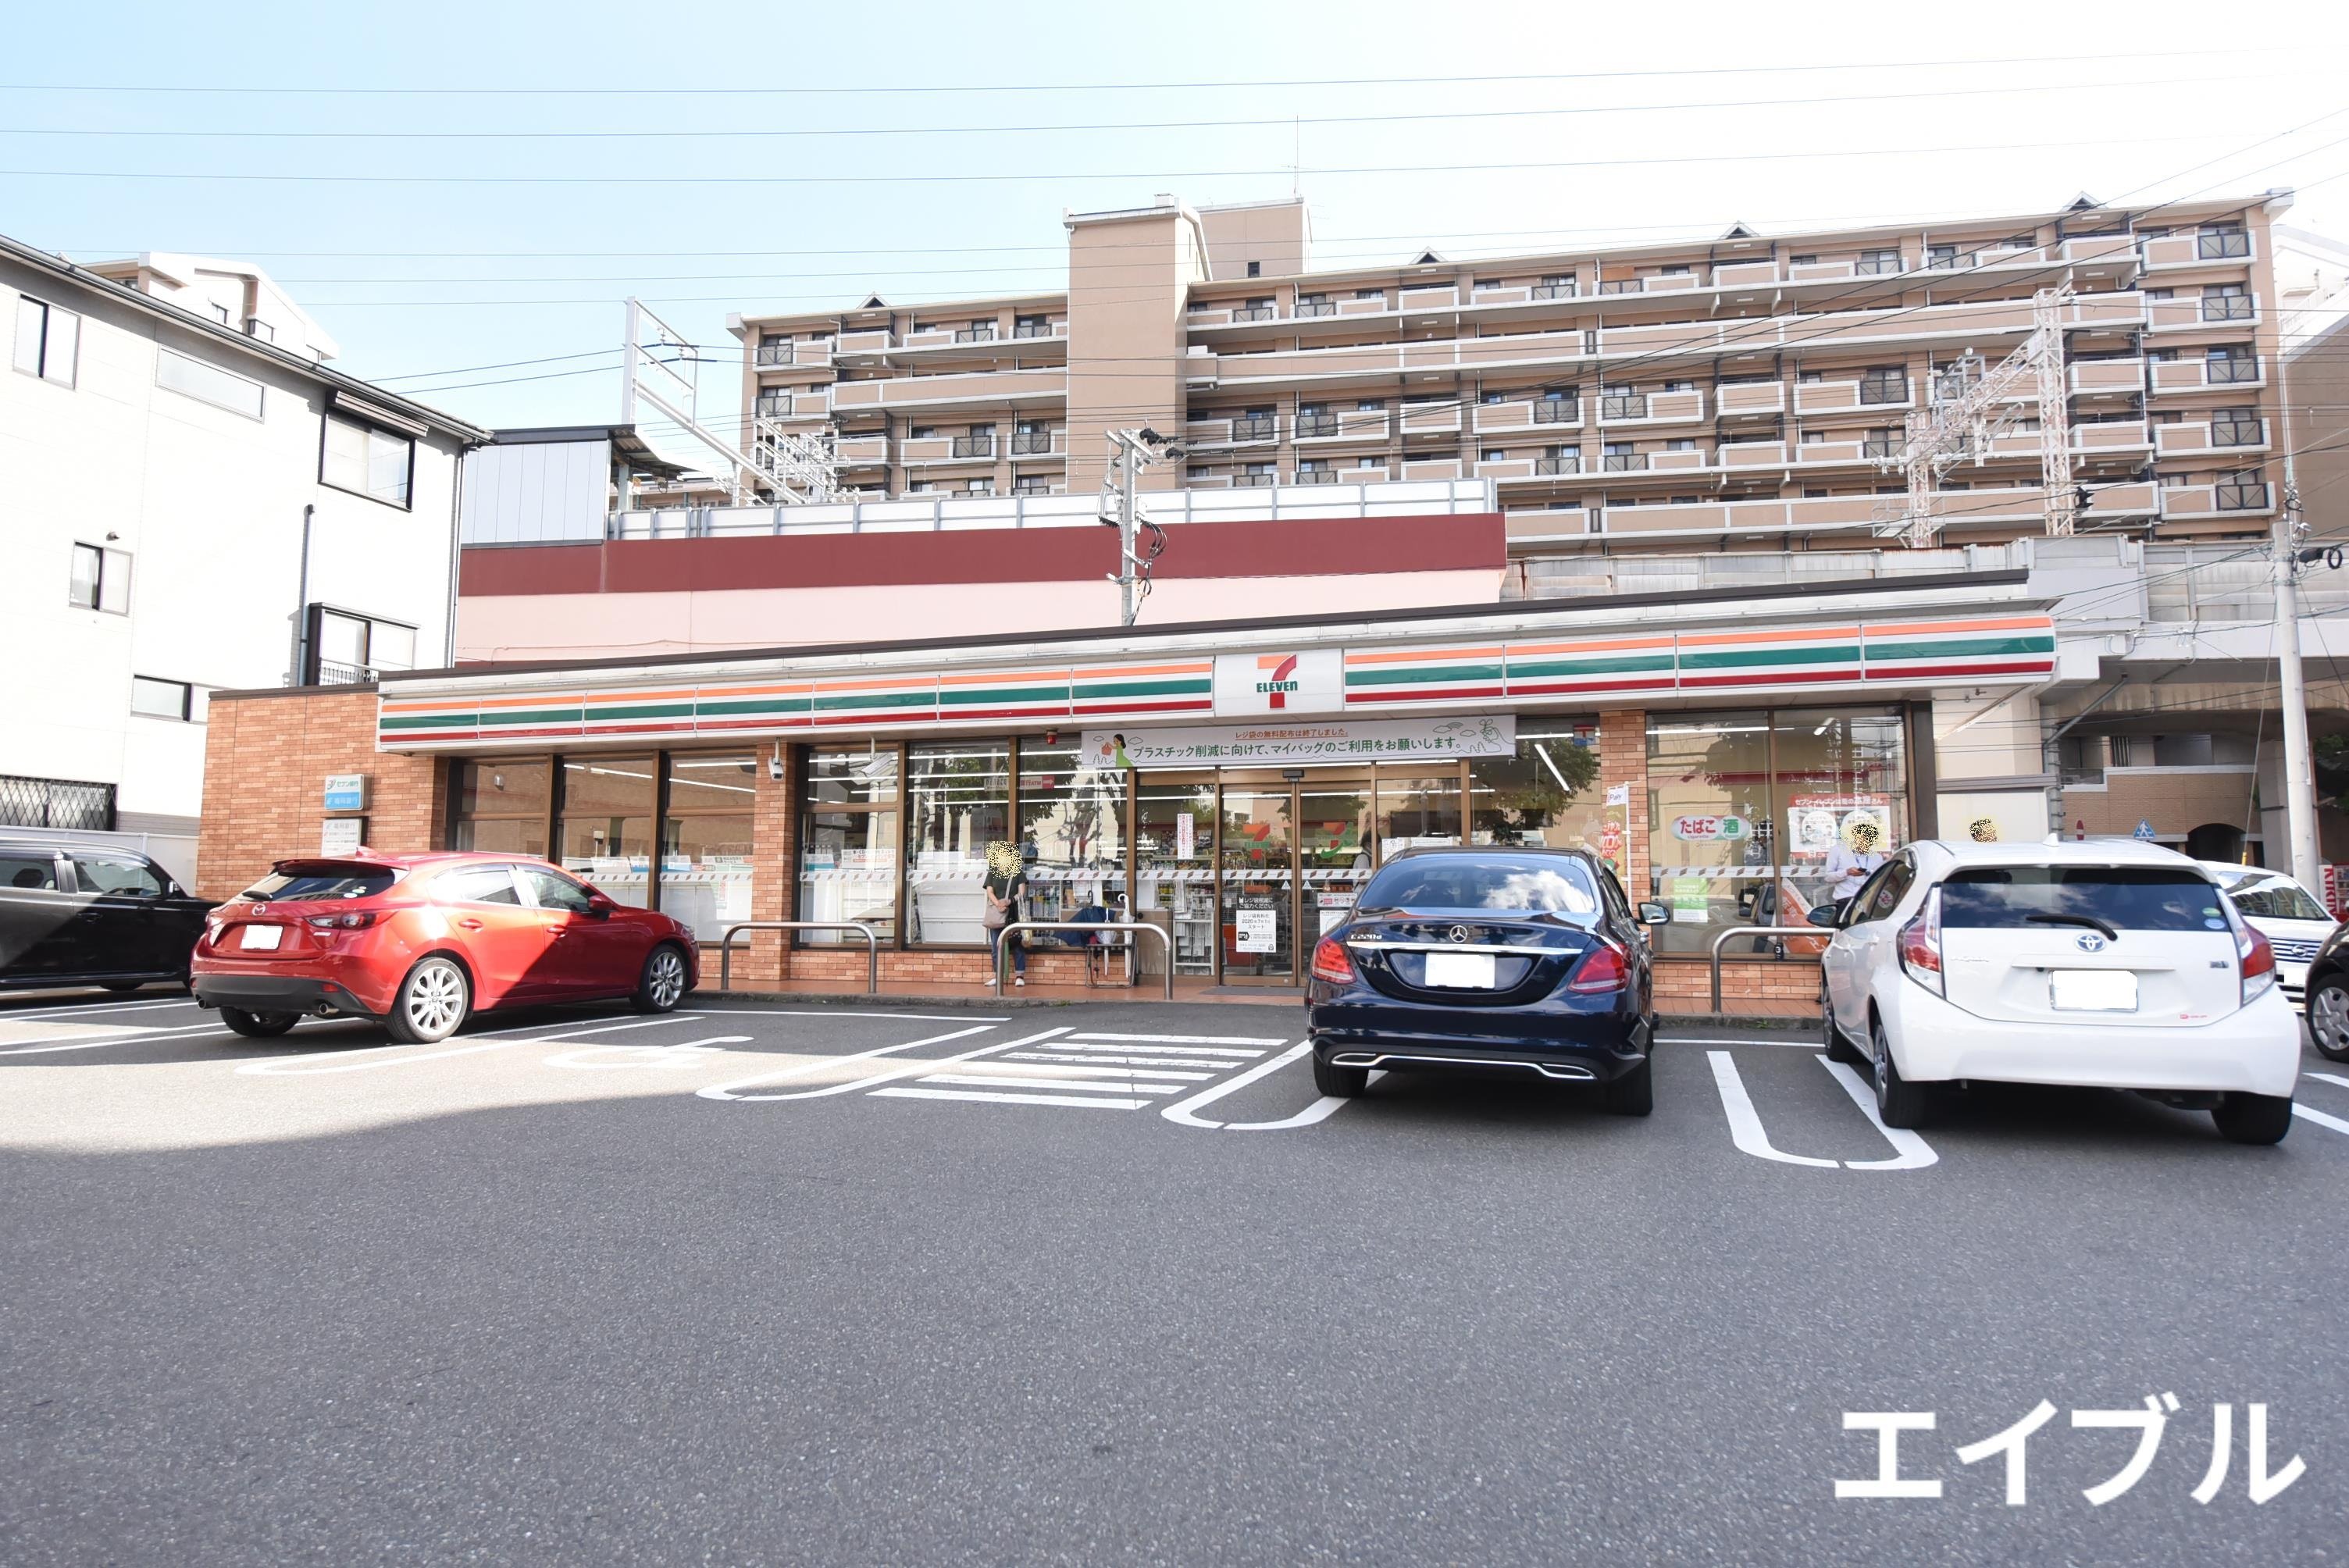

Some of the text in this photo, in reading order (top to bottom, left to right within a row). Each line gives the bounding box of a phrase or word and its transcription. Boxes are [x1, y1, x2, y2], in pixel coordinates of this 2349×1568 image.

[1235, 728, 1349, 739] レジ袋の無料配布は終了しました。
[1133, 736, 1461, 758] プラスチック削減に向けて、マイバッグのご利用をお願いします。
[1681, 819, 1739, 834] たばこ 酒
